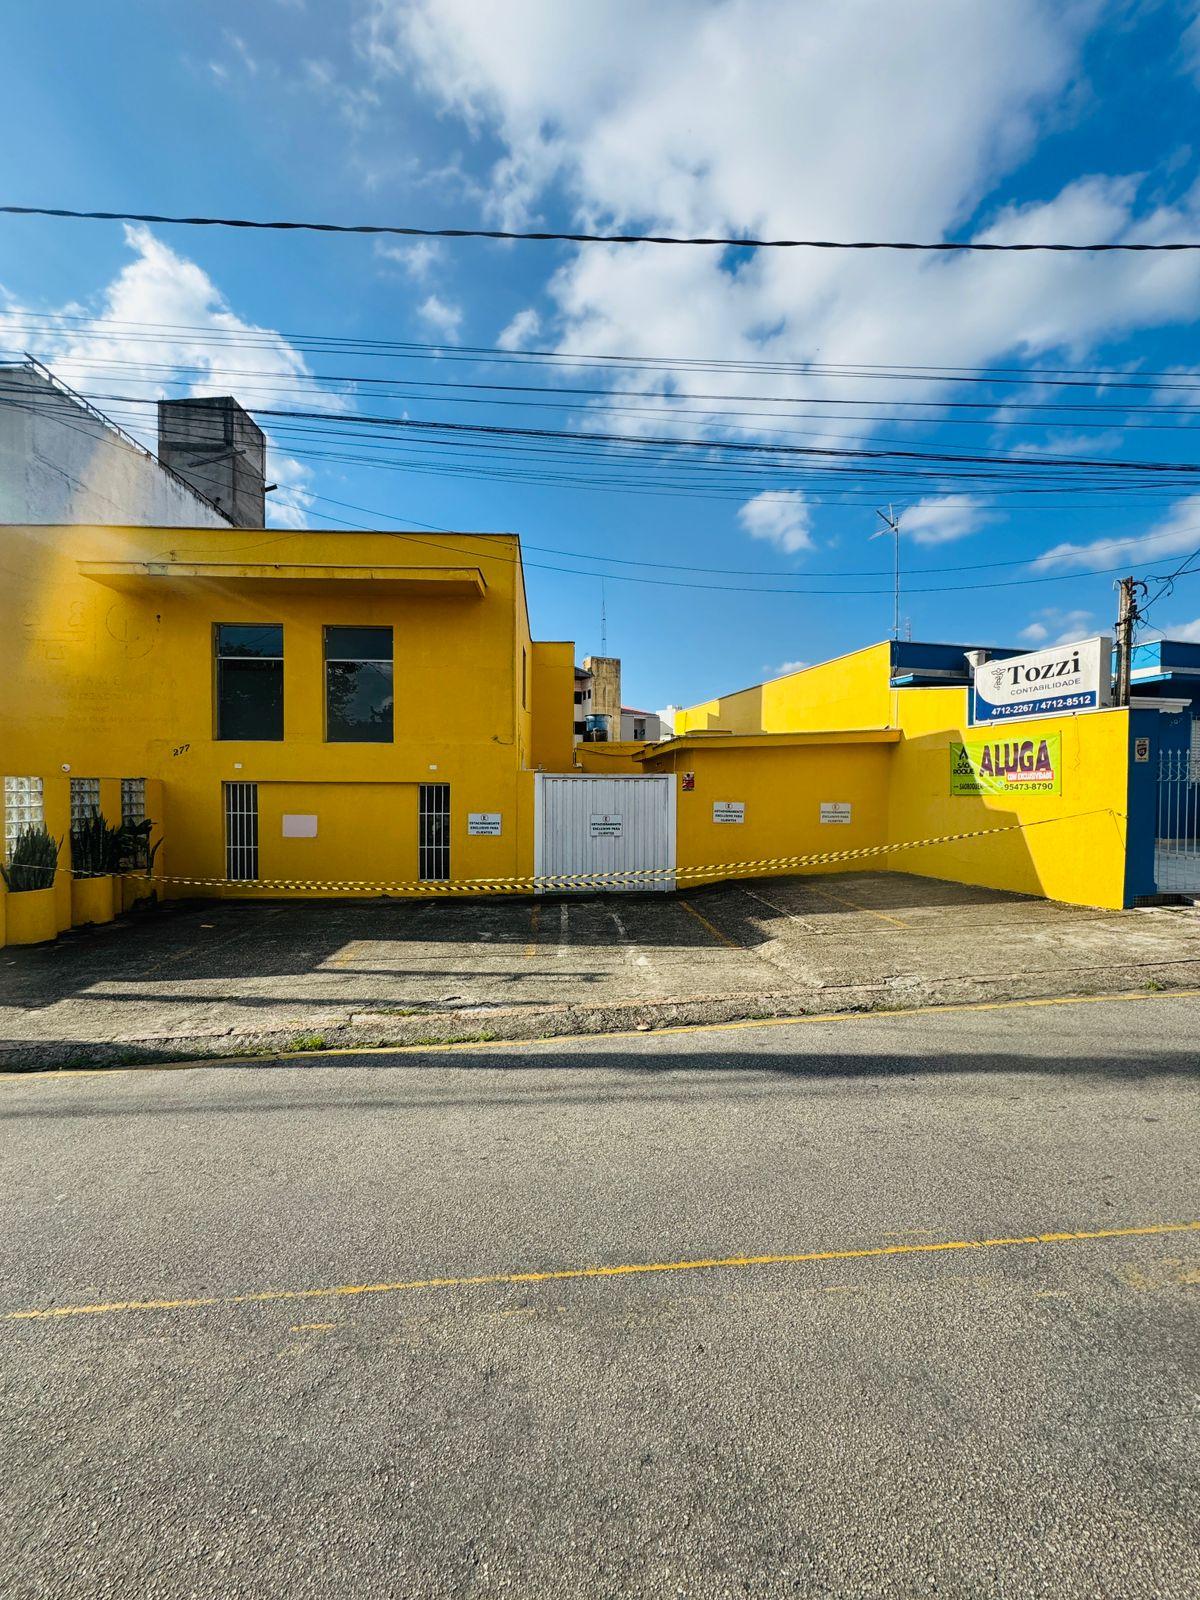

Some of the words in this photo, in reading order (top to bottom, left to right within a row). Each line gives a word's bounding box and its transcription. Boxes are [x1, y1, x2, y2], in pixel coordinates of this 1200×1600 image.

[1007, 650, 1081, 685] Tozzi
[1010, 678, 1081, 695] CONTABILIDADE
[991, 703, 1034, 715] 4712-2267
[1040, 695, 1092, 710] 4712-8512
[173, 744, 190, 757] 277
[979, 740, 1052, 777] ALUGA
[1004, 782, 1053, 791] 95473-8790
